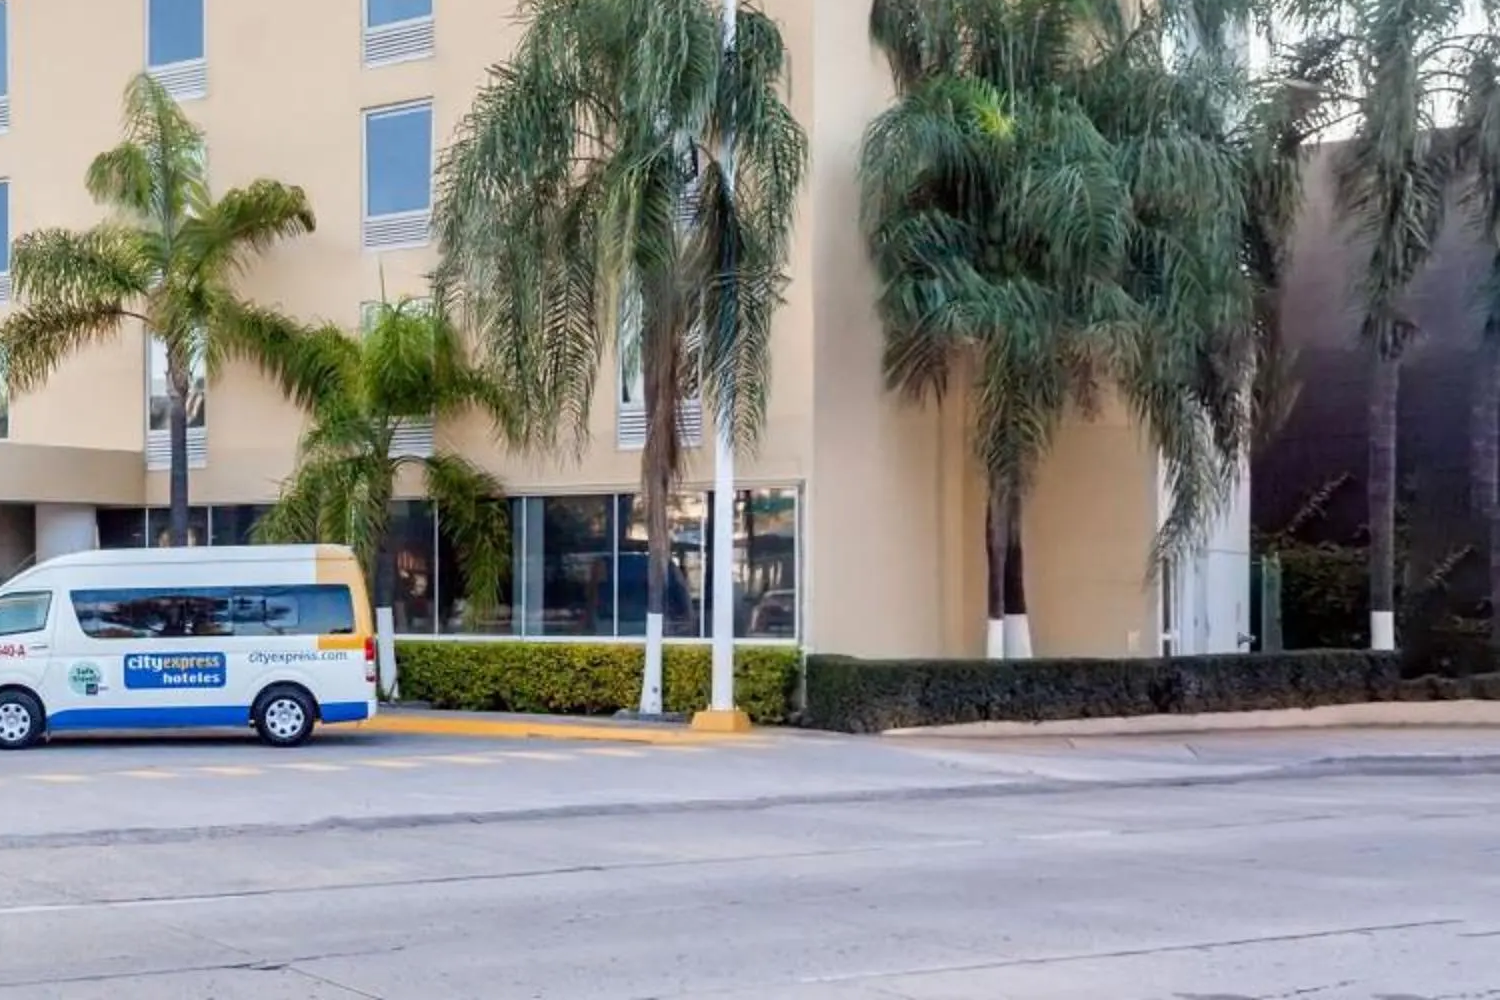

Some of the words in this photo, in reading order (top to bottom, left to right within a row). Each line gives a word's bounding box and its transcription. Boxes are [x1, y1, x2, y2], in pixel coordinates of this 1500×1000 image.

[127, 655, 222, 672] cityexpress
[248, 650, 348, 665] cityexpress.com
[163, 672, 221, 685] hoteles
